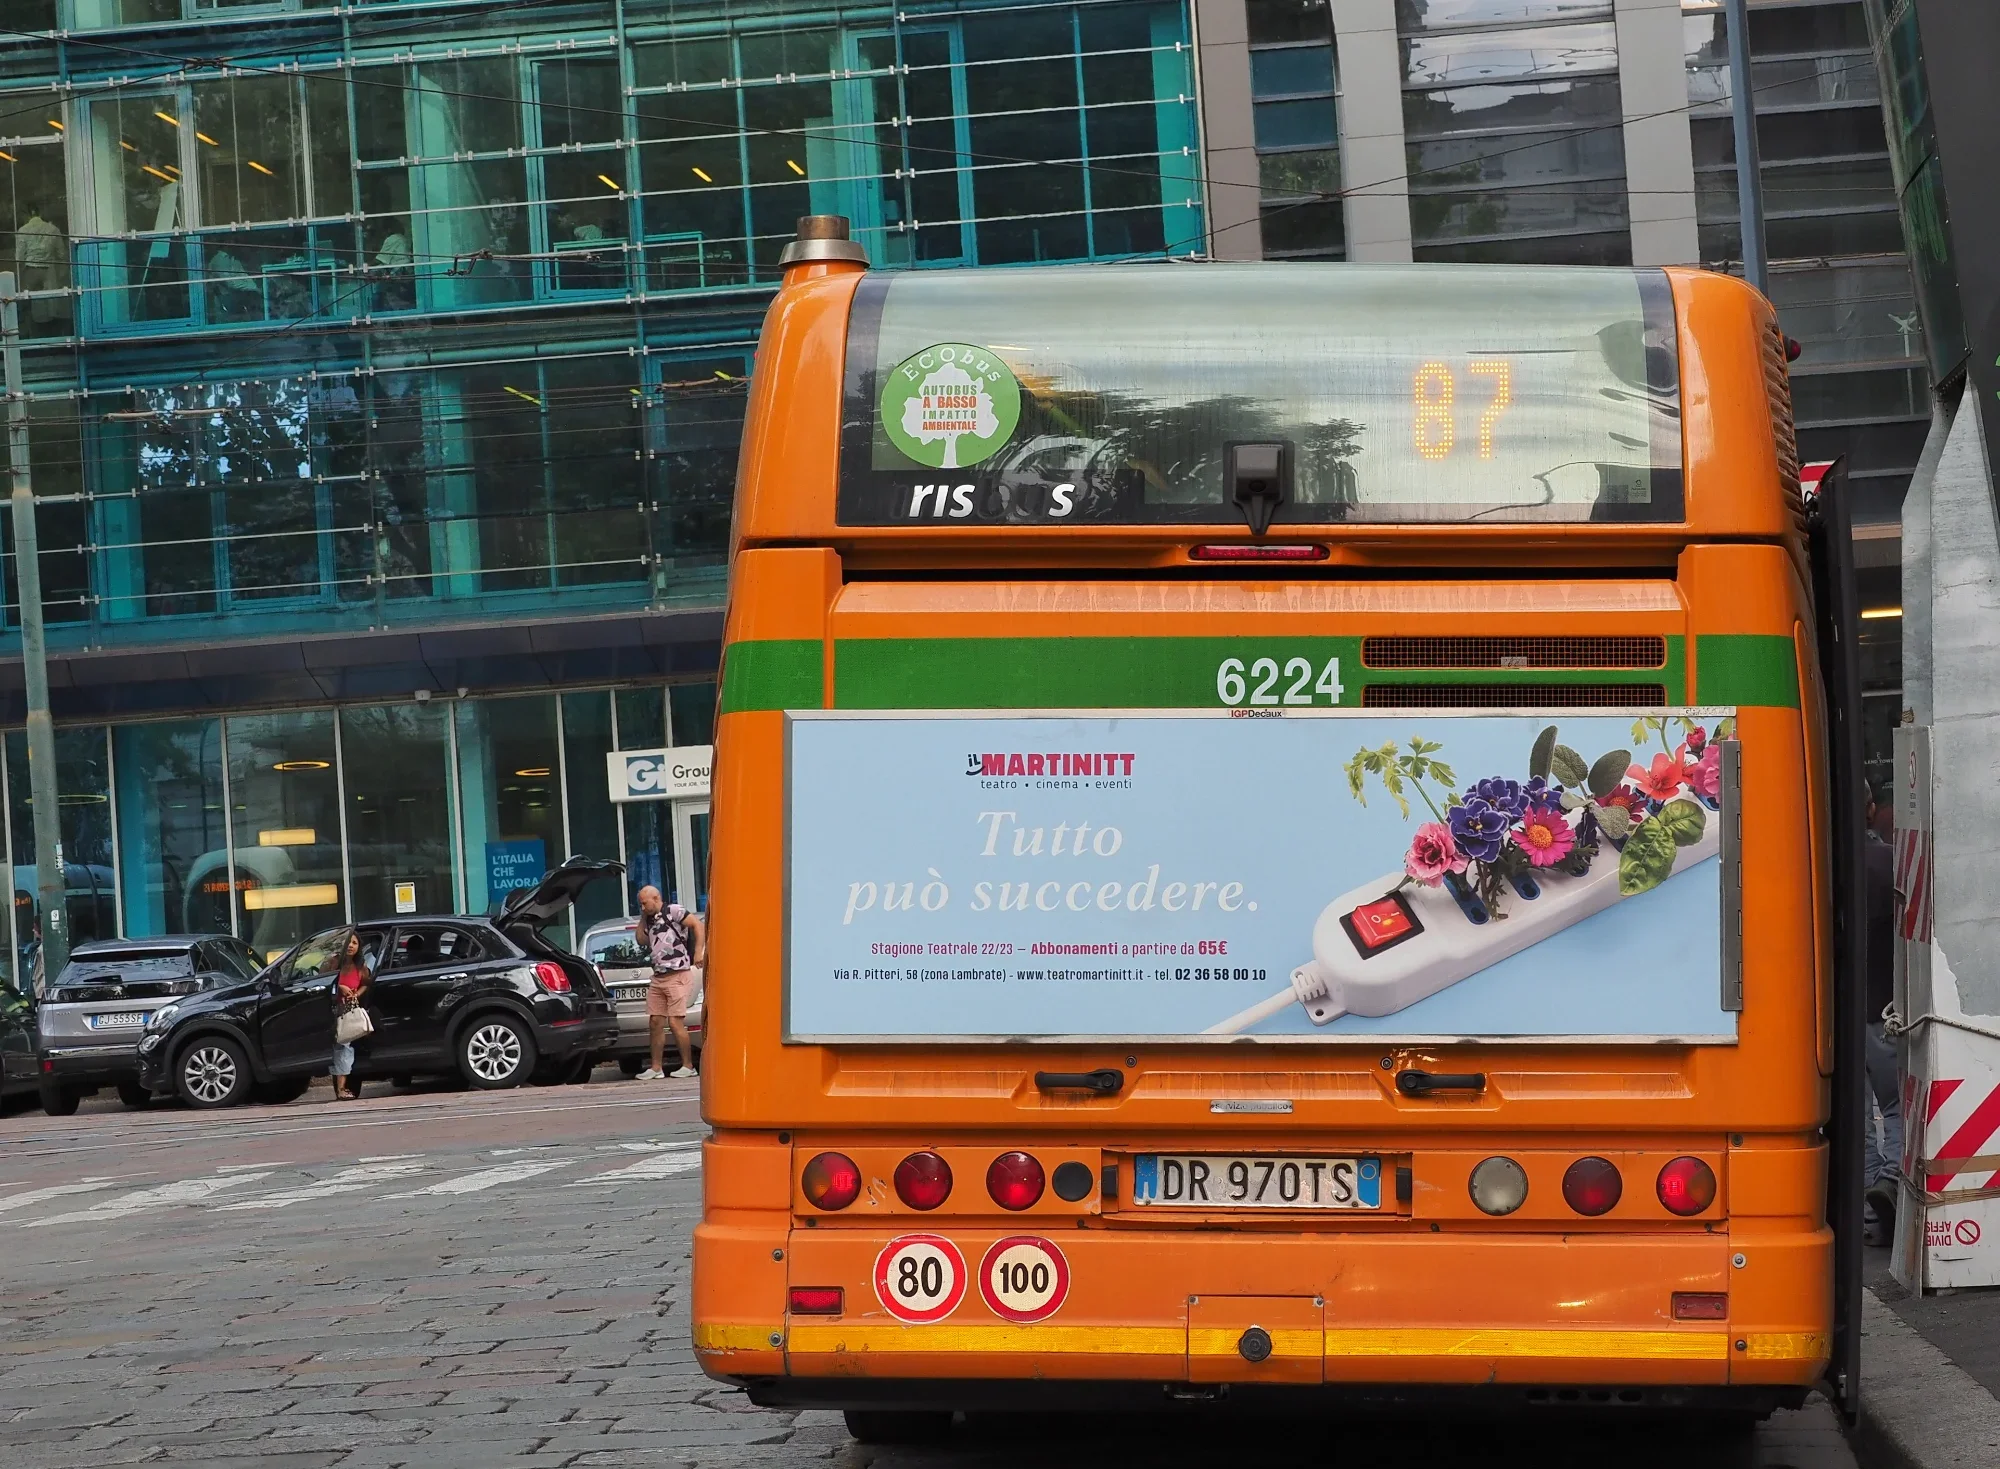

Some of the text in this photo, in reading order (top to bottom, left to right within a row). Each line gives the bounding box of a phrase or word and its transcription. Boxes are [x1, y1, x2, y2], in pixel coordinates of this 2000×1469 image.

[901, 347, 1001, 382] ECObus
[922, 384, 977, 396] AUTOBUS
[922, 396, 977, 409] A BASSO
[922, 410, 977, 420] IMPATTO
[1415, 362, 1508, 459] 87
[922, 421, 977, 431] AMBIENTALE
[1216, 656, 1345, 706] 6224
[1230, 709, 1283, 718] IGPDecaux
[981, 753, 1136, 776] MARTINITT
[627, 759, 710, 792] Gi Grou
[980, 778, 1132, 789] teatro cinema eventi
[976, 811, 1124, 858] Tutto
[492, 866, 515, 877] CHE
[493, 877, 540, 889] LAVORA
[843, 863, 1258, 925] può succedere.
[871, 942, 924, 958] Stagione
[927, 942, 978, 955] Teatrale
[981, 943, 1013, 955] 22/23
[1031, 941, 1118, 955] Abbonamenti
[1121, 944, 1129, 955] a
[1132, 942, 1177, 958] partire
[1180, 942, 1195, 955] da
[1198, 940, 1228, 955] 65€
[833, 968, 850, 980] Via
[852, 969, 862, 980] R.
[864, 968, 903, 982] Pitteri,
[906, 969, 918, 980] 58
[920, 968, 949, 982] (zona
[951, 968, 1006, 982] Lambrate)
[1017, 968, 1144, 980] www.teatromartinitt.it
[1155, 968, 1172, 981] tel.
[1175, 968, 1191, 981] 02
[1194, 968, 1210, 981] 36
[1213, 968, 1229, 981] 58
[1233, 968, 1249, 981] 00
[1252, 969, 1266, 981] 10
[615, 987, 649, 999] DR 068
[1162, 1159, 1210, 1201] DR
[1227, 1161, 1353, 1202] 970TS
[1926, 1220, 1952, 1233] AFFIS
[1926, 1234, 1952, 1247] DIVIE
[897, 1256, 1049, 1298] 80 100
